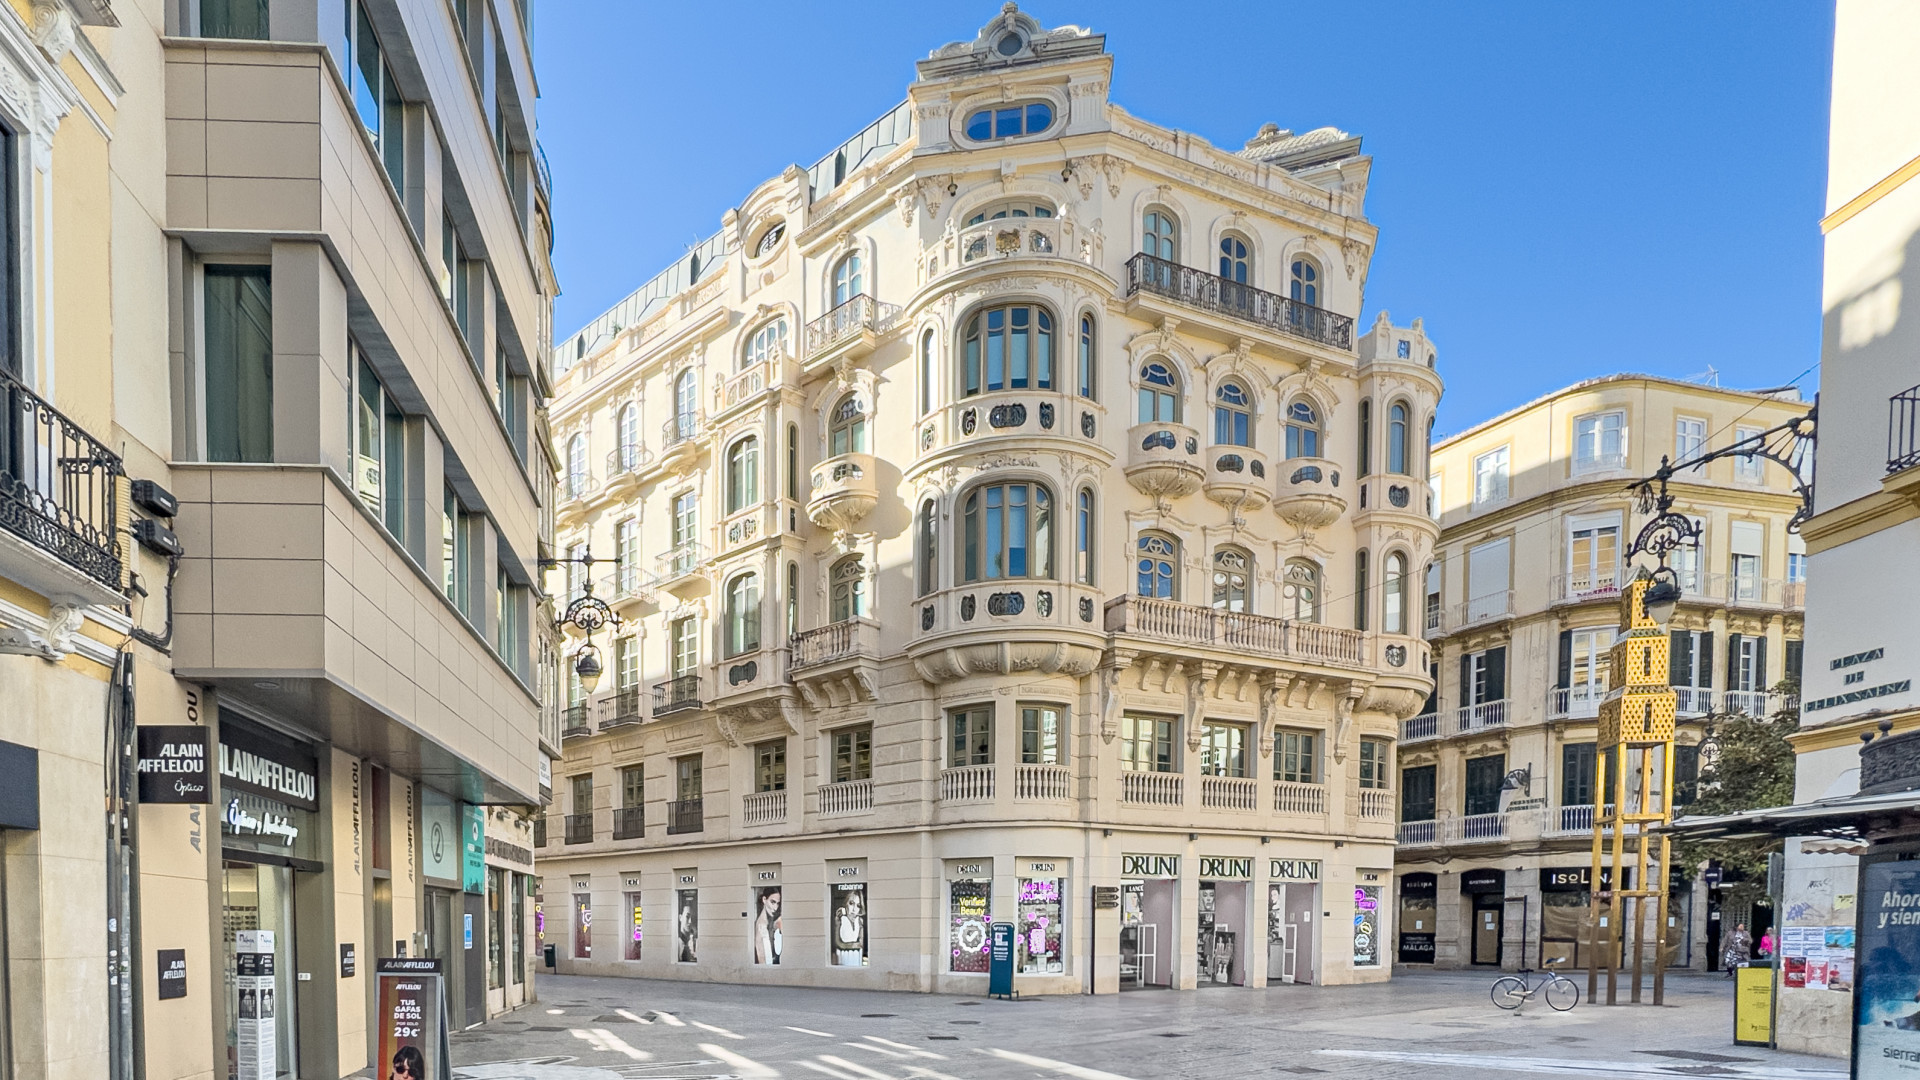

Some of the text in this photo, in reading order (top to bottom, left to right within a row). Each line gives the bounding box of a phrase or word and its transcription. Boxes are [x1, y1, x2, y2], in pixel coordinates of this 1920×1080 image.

[1830, 648, 1883, 670] PLAZA
[1844, 671, 1864, 685] DE
[1854, 679, 1909, 702] SAENZ
[159, 743, 203, 758] ALAIN
[137, 758, 204, 773] AFFLELOU
[1122, 855, 1178, 876] DRUNI
[1200, 858, 1251, 877] DRUNI
[1270, 860, 1318, 880] DRUNI
[1552, 868, 1613, 885] ISOLN
[959, 896, 986, 906] Verified
[1881, 891, 1920, 907] Ahor
[960, 907, 986, 916] Beauty
[1877, 912, 1889, 928] y
[170, 960, 185, 970] ALAIN
[162, 969, 186, 980] AFFLELOU
[1882, 1045, 1920, 1063] sierra
